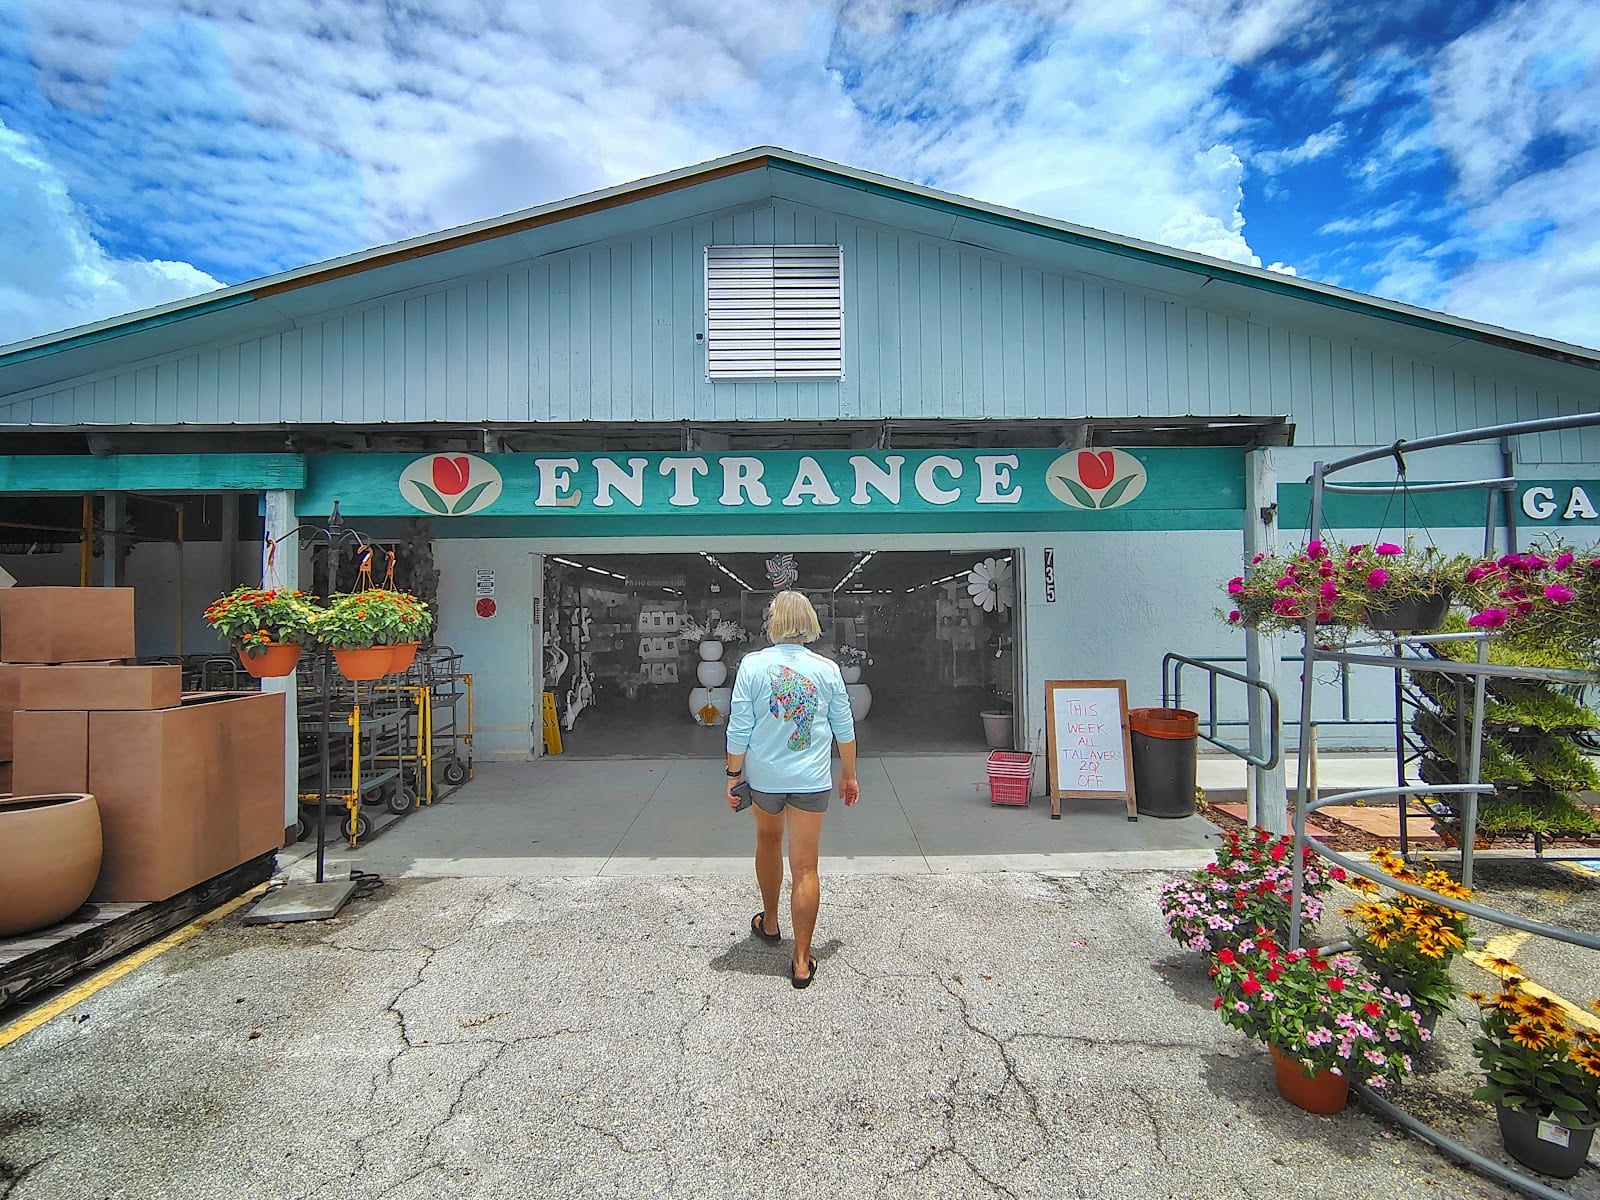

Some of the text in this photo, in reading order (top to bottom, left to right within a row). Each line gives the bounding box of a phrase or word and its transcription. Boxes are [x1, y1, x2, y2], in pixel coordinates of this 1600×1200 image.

[533, 453, 1024, 510] ENTRANCE
[1522, 485, 1599, 520] GA
[1045, 548, 1056, 602] 735
[1066, 699, 1099, 717] THIS
[1067, 722, 1108, 736] WEEK
[1078, 736, 1101, 748] ALL
[1077, 774, 1105, 789] OFF
